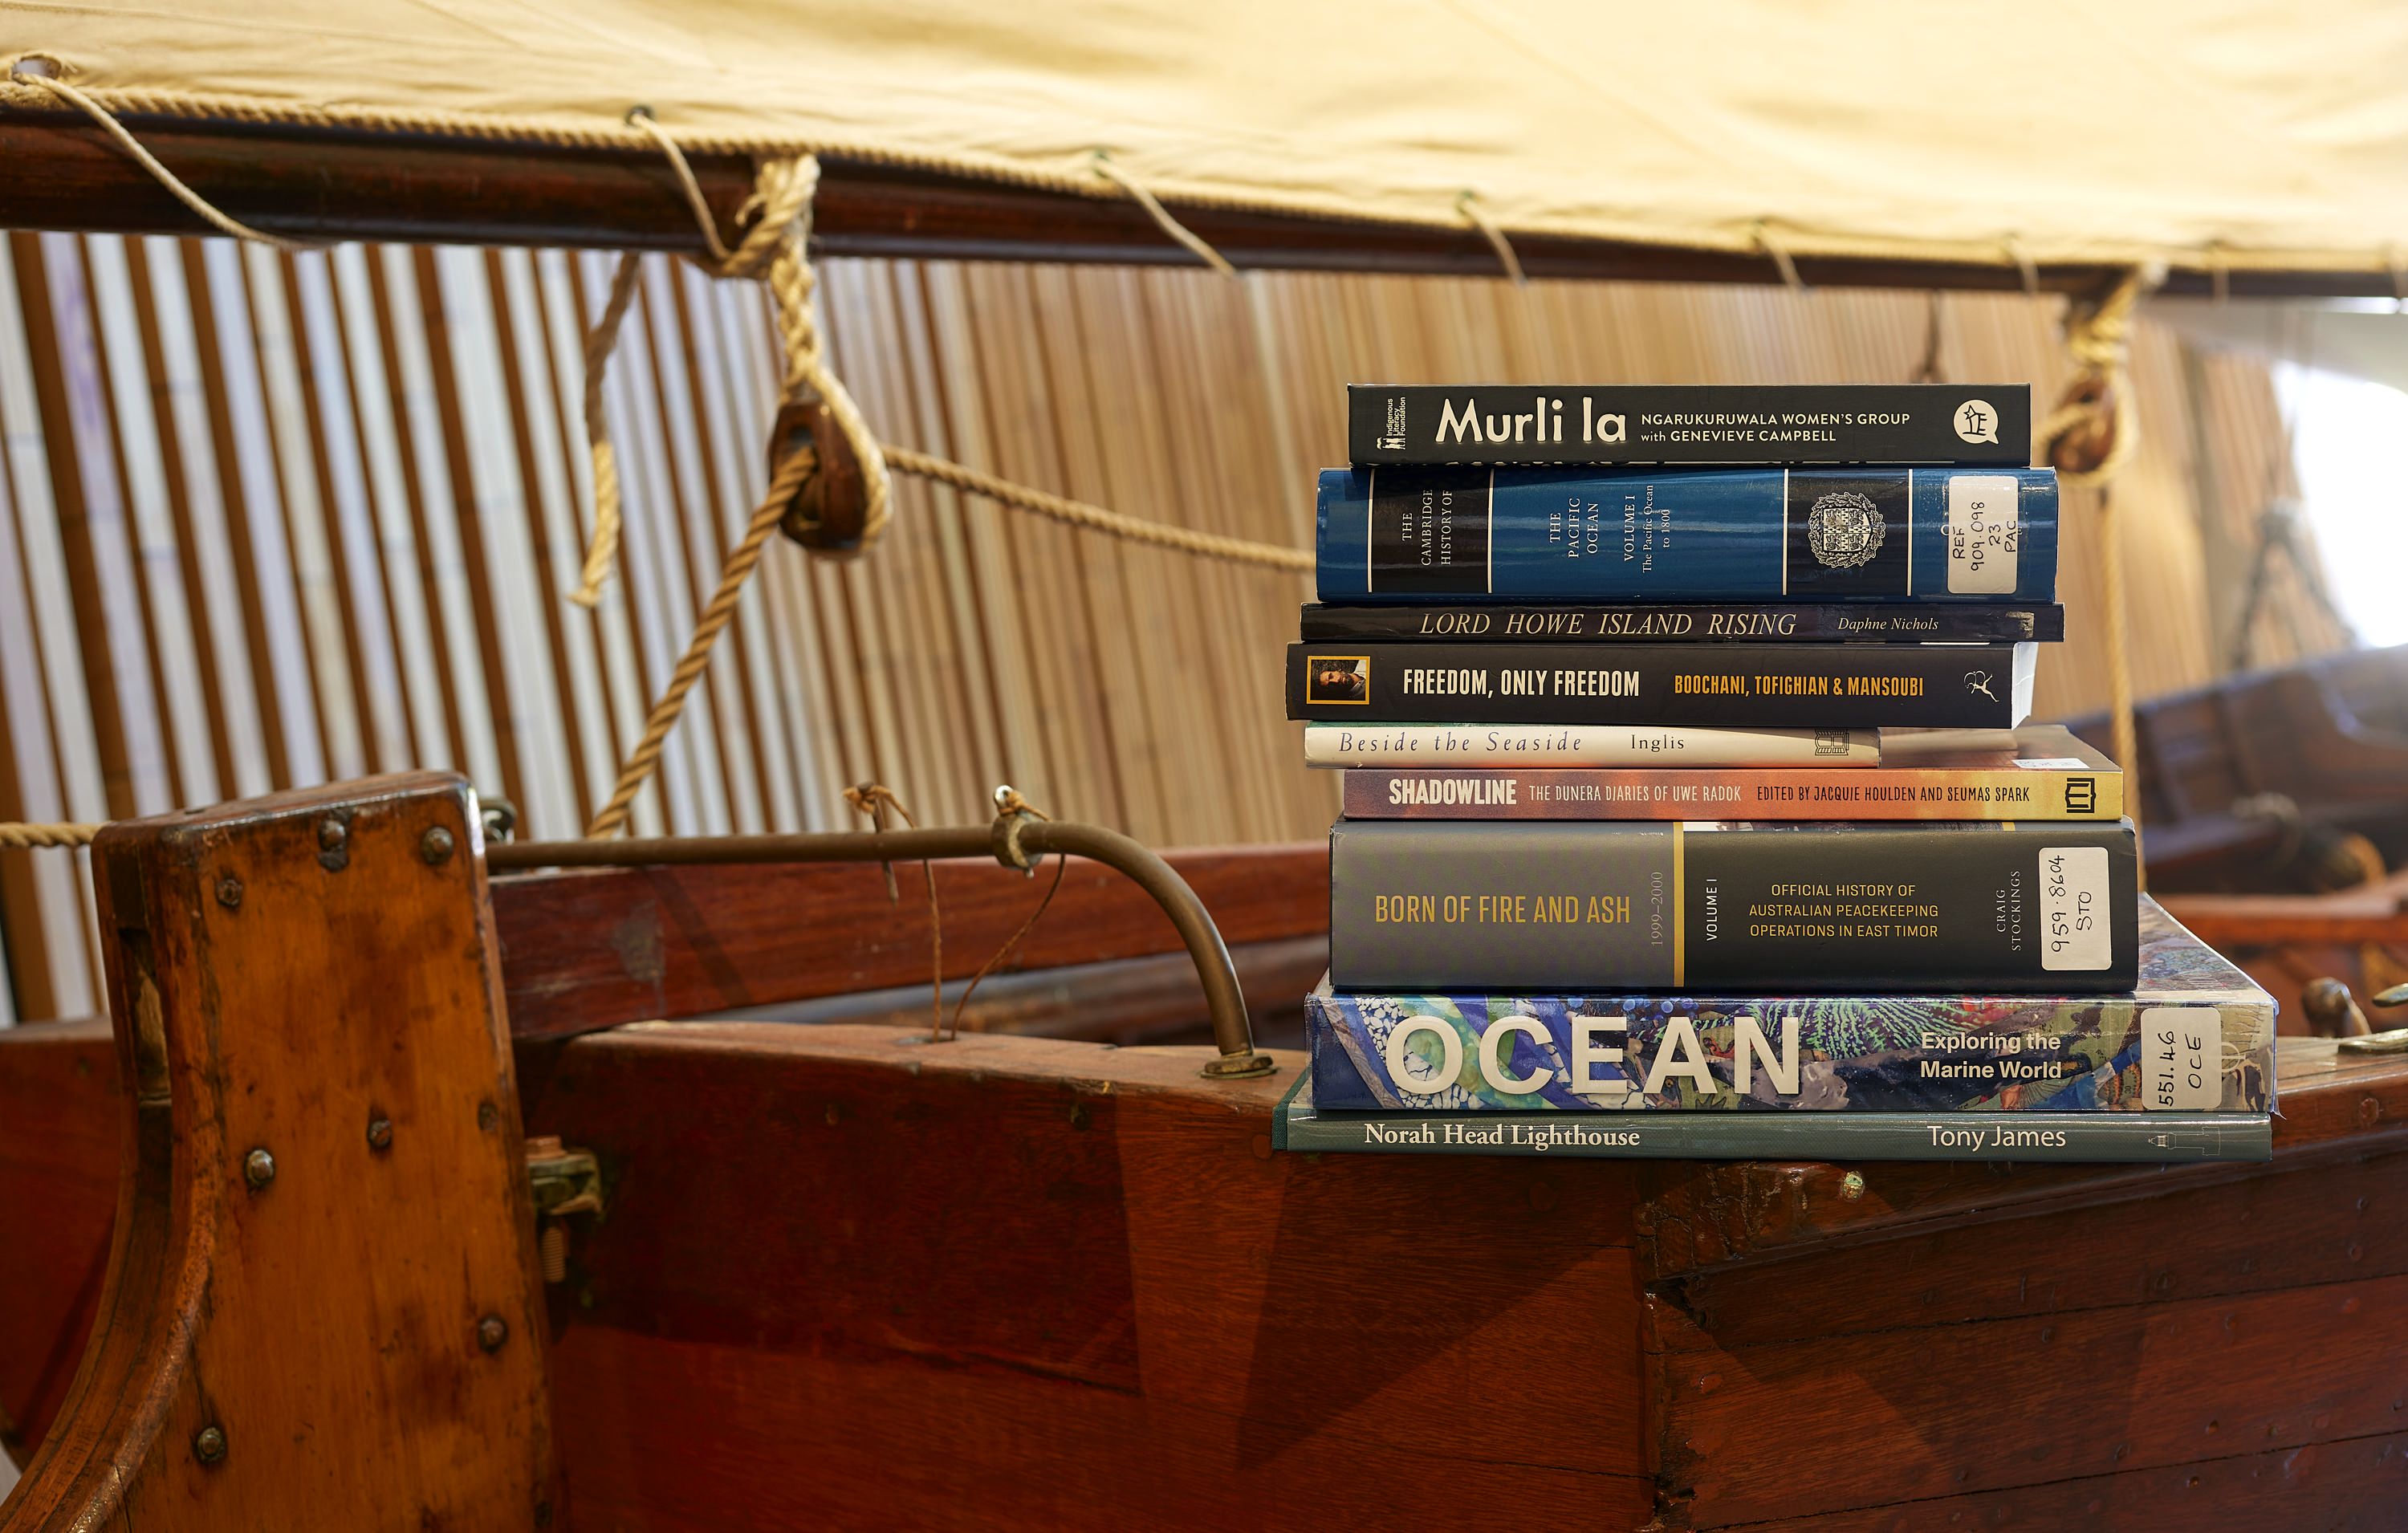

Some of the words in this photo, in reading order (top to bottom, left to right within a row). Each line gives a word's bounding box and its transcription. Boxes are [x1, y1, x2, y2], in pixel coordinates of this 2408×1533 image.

[1386, 398, 1394, 437] Indigenous
[1393, 408, 1401, 437] Literacy
[1435, 396, 1564, 442] Murli
[1582, 396, 1627, 442] la
[1641, 413, 1778, 425] NGARUKURUWALA
[1857, 413, 1910, 425] GROUP
[1641, 430, 1666, 441] with
[1670, 430, 1755, 441] GENEVIEVE
[1759, 430, 1837, 441] CAMPBELL
[1442, 489, 1454, 504] OF
[1643, 484, 1654, 515] Ocean
[1401, 512, 1413, 543] THE
[1421, 489, 1434, 567] CAMBRIDGE
[1549, 512, 1562, 545] THE
[1568, 498, 1580, 558] PACIFIC
[1586, 502, 1599, 554] OCEAN
[1624, 504, 1635, 562] VOLUME
[1642, 518, 1653, 551] Pacific
[1661, 509, 1671, 533] 1800
[1988, 524, 2001, 547] 23
[1441, 506, 1454, 566] HISTORY
[1662, 537, 1670, 548] to
[1952, 526, 1966, 559] REF
[1971, 502, 1985, 571] 909.098
[2003, 520, 2017, 553] PAC
[1642, 554, 1652, 573] The
[1419, 612, 1491, 634] LORD
[1504, 613, 1584, 634] HOWE
[1597, 613, 1692, 635] ISLAND
[1706, 613, 1796, 636] RISING
[1837, 617, 1887, 633] Daphne
[1890, 617, 1939, 630] Nichols
[1403, 669, 1494, 699] FREEDOM,
[1501, 669, 1548, 696] ONLY
[1554, 670, 1639, 697] FREEDOM
[1674, 674, 1750, 697] BOOCHANI,
[1754, 675, 1828, 695] TOFIGHIAN
[1832, 677, 1843, 696] &
[1848, 677, 1923, 697] MANSOUBI
[1338, 731, 1418, 752] Beside
[1434, 731, 1470, 751] the
[1486, 730, 1581, 751] Seaside
[1631, 734, 1685, 753] Inglis
[1389, 779, 1517, 805] SHADOWLINE
[1528, 785, 1551, 801] THE
[1555, 785, 1601, 801] DUNERA
[1605, 785, 1649, 802] DIARIES
[1654, 785, 1669, 801] OF
[1673, 785, 1698, 802] UWE
[1702, 785, 1742, 802] RADOK
[1757, 786, 1794, 801] EDITED
[1798, 786, 1810, 801] BY
[1813, 786, 1860, 802] JACQUIE
[1865, 787, 1915, 801] HOULDEN
[1920, 787, 1942, 802] AND
[1947, 787, 1991, 802] SEUMAS
[1995, 787, 2030, 802] SPARK
[1771, 884, 1832, 897] OFFICIAL
[1837, 884, 1893, 897] HISTORY
[1898, 884, 1916, 897] OF
[2048, 855, 2070, 953] 959.8604
[1376, 895, 1435, 923] BORN
[1443, 895, 1471, 923] OF
[1479, 896, 1526, 923] FIRE
[1533, 896, 1579, 923] AND
[1586, 896, 1630, 924] ASH
[1706, 887, 1718, 941] VOLUME
[1749, 904, 1832, 917] AUSTRALIAN
[1837, 905, 1938, 917] PEACEKEEPING
[1995, 889, 2006, 933] CRAIG
[2011, 871, 2021, 951] STOCKINGS
[2076, 891, 2093, 931] STO
[1750, 924, 1835, 937] OPERATIONS
[1839, 925, 1853, 937] IN
[1857, 925, 1894, 937] EAST
[1894, 925, 1938, 937] TIMOR
[1385, 1016, 1800, 1095] OCEAN
[1918, 1030, 2022, 1054] Exploring
[2024, 1030, 2064, 1052] the
[1918, 1059, 1997, 1080] Marine
[1996, 1059, 2064, 1081] World
[2157, 1031, 2176, 1107] 551.46
[2184, 1032, 2203, 1090] OCE
[1364, 1123, 1437, 1145] Norah
[1442, 1124, 1503, 1145] Head
[1510, 1124, 1641, 1151] Lighthouse
[1927, 1126, 1983, 1152] Tony
[1991, 1125, 2066, 1148] James
